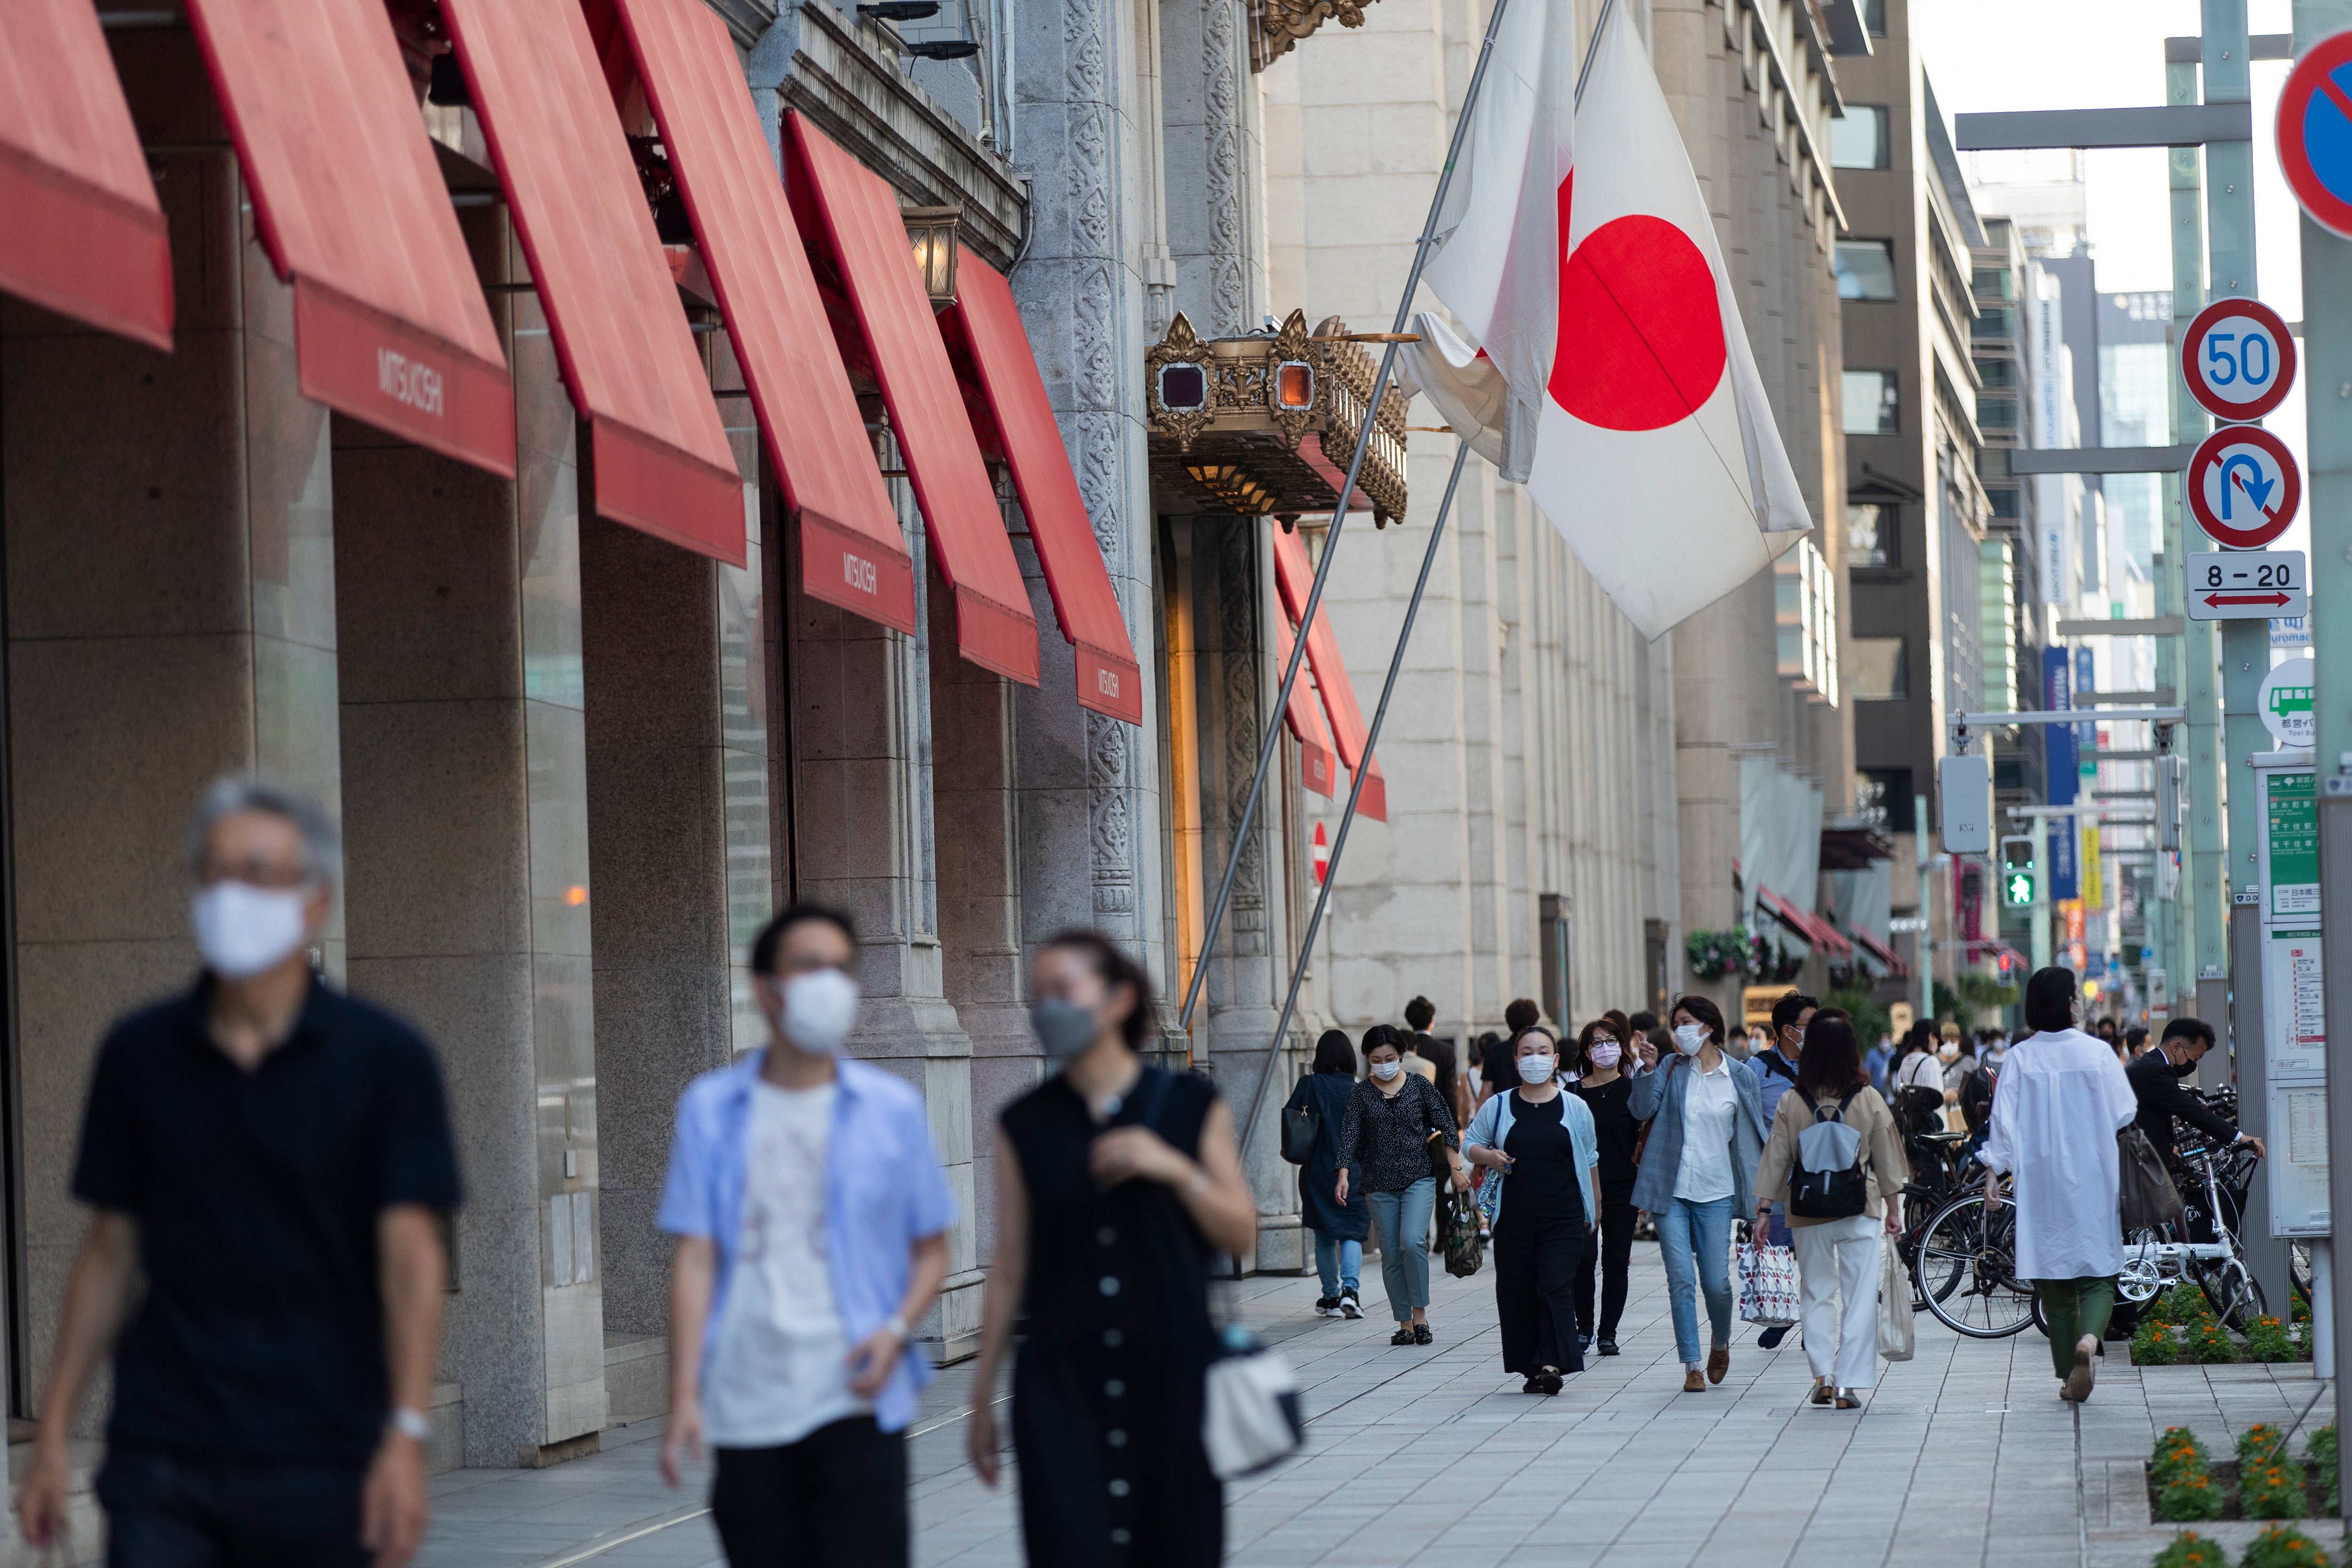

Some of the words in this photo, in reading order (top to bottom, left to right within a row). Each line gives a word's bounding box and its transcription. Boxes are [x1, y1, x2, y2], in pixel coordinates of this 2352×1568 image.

[2209, 334, 2270, 385] 50
[843, 551, 876, 595] MITSUKOSHI
[2270, 632, 2311, 644] uromac
[2282, 718, 2314, 728] 都営バ
